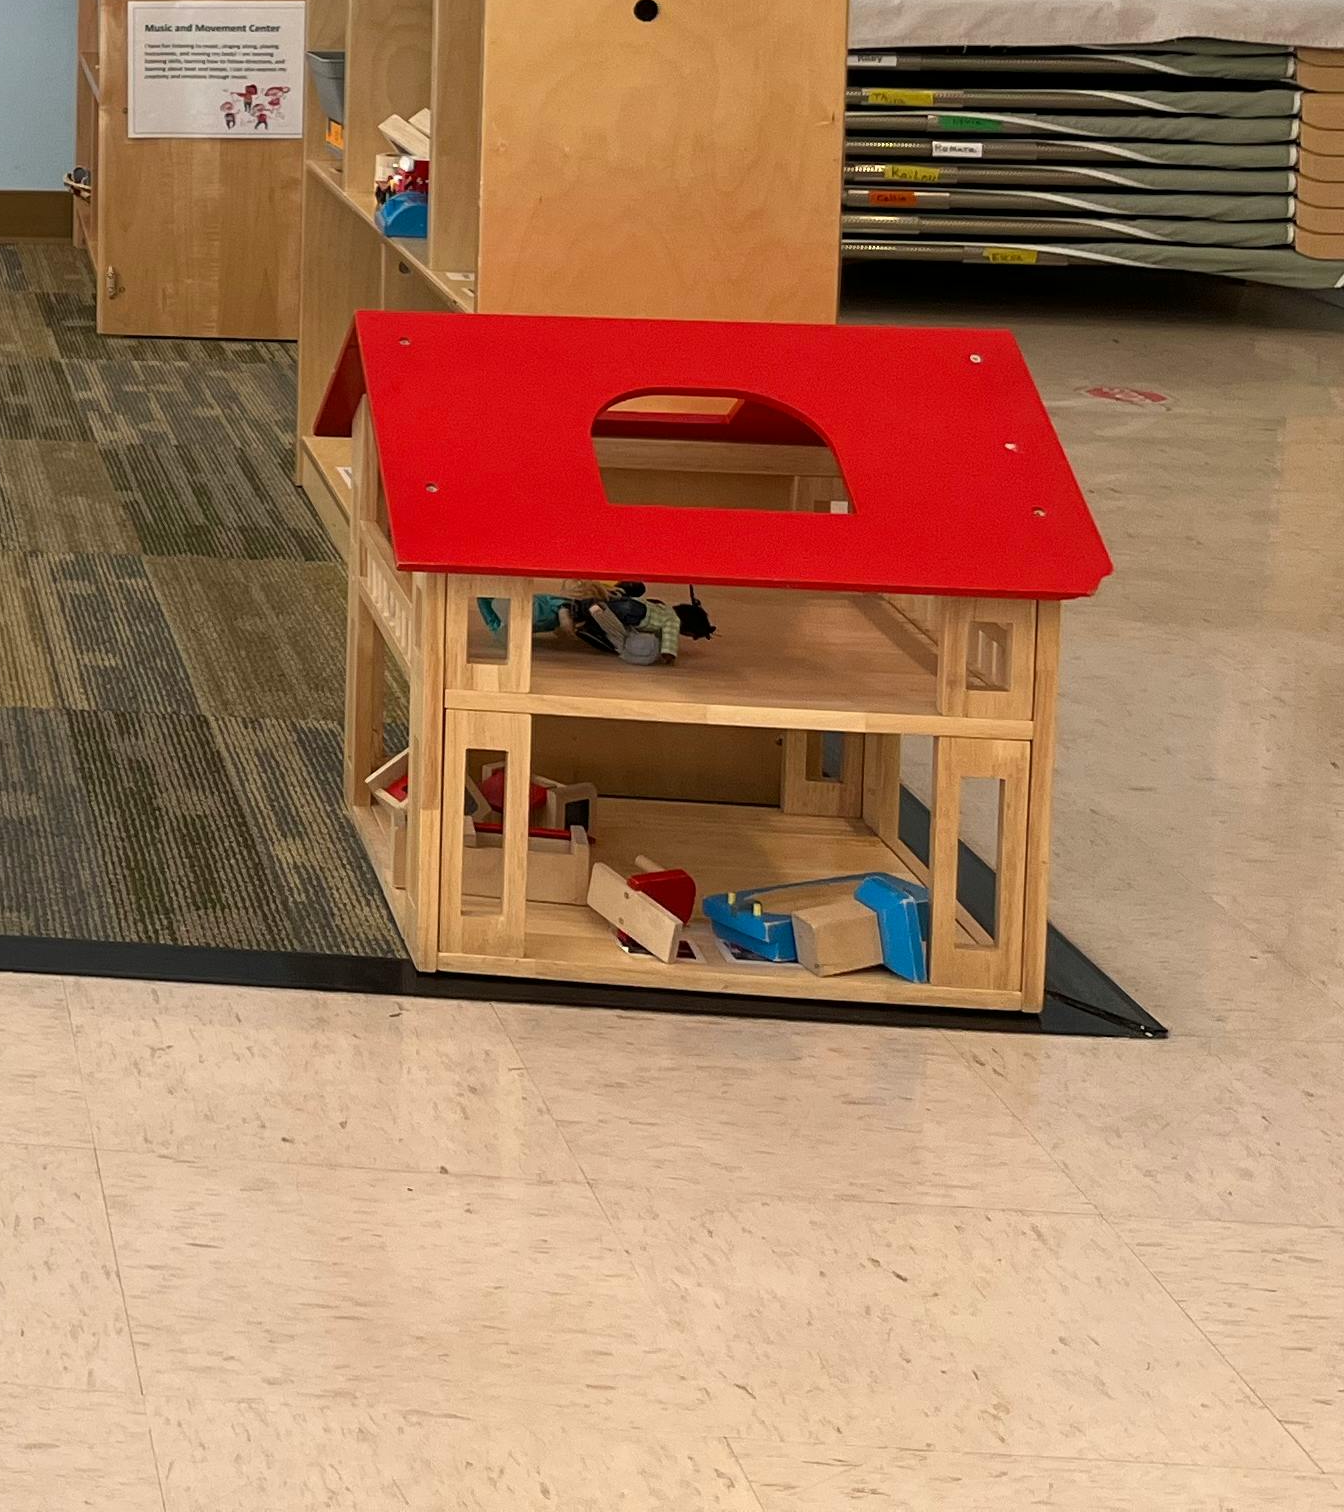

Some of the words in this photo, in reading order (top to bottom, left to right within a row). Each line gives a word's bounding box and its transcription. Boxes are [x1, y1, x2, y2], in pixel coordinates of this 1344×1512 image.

[144, 24, 172, 33] Music
[174, 24, 193, 33] and
[195, 24, 247, 33] Movement
[248, 24, 281, 33] Center
